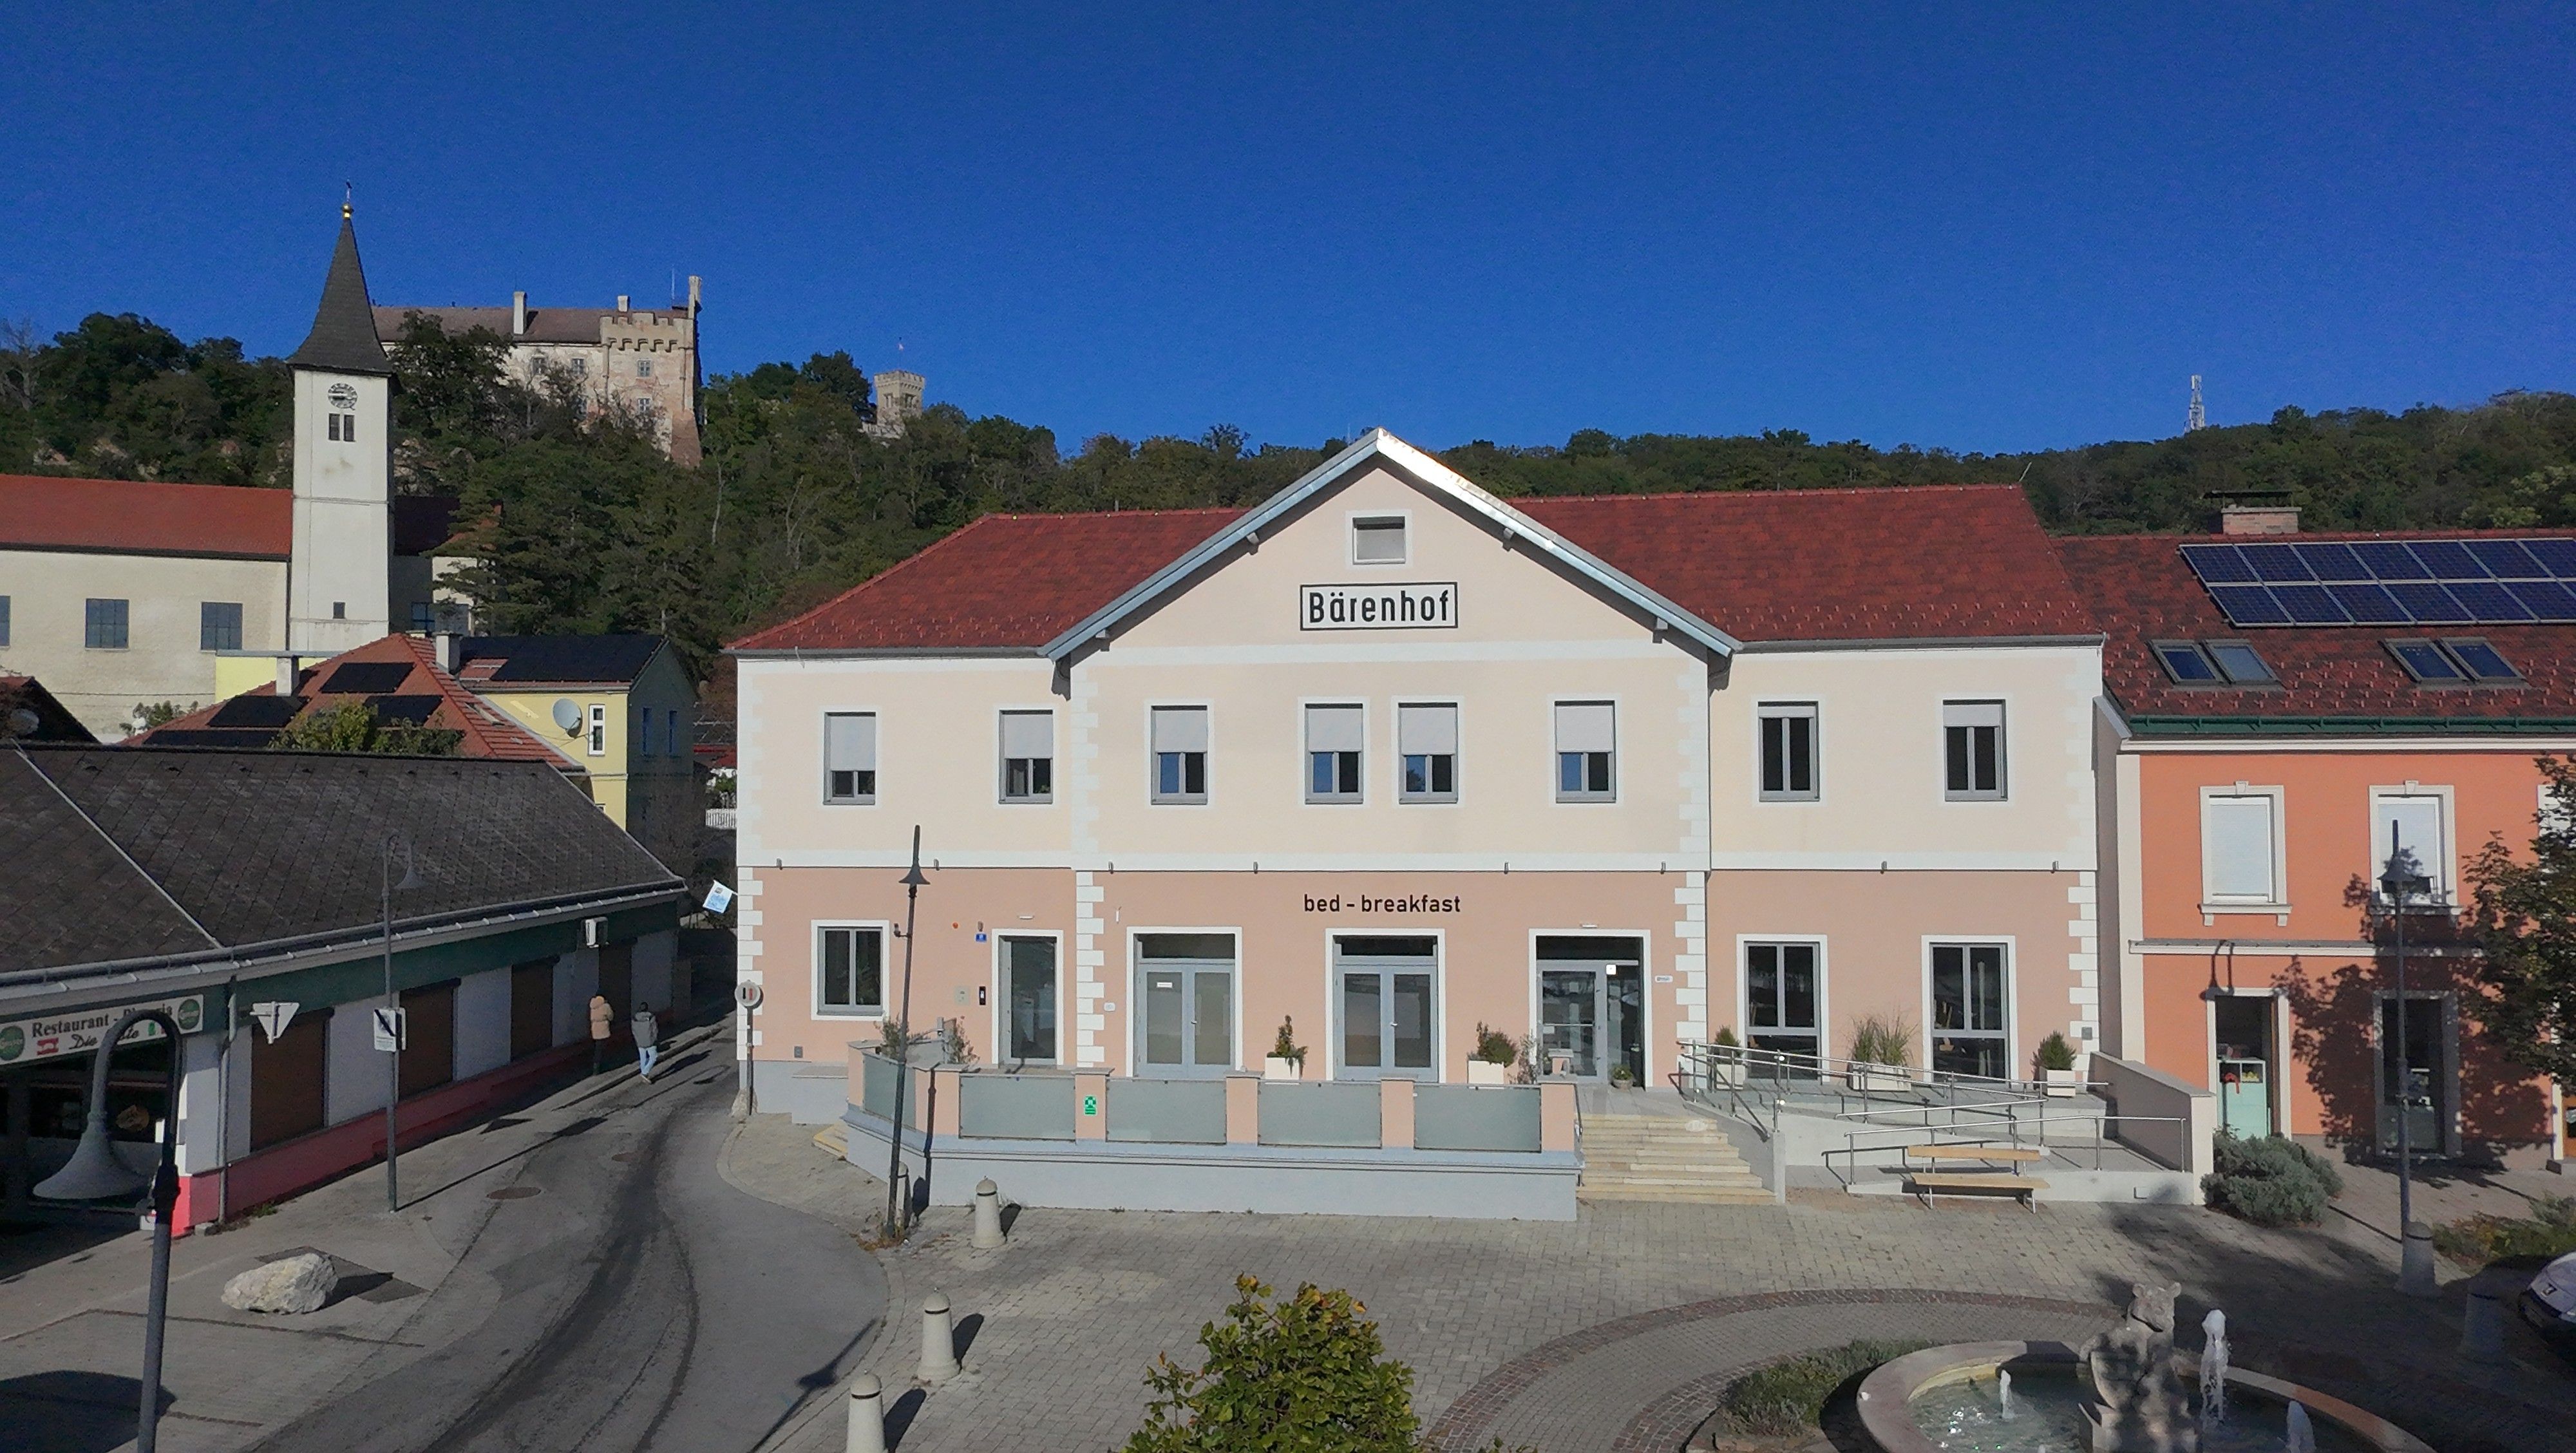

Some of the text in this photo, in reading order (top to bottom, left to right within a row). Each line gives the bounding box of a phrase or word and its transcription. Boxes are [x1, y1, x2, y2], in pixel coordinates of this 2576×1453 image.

[1309, 590, 1448, 623] Bärenhof
[1304, 894, 1340, 912] bed
[1361, 895, 1461, 912] breakfast
[32, 1014, 109, 1038] Restaurant
[68, 1034, 98, 1050] Die
